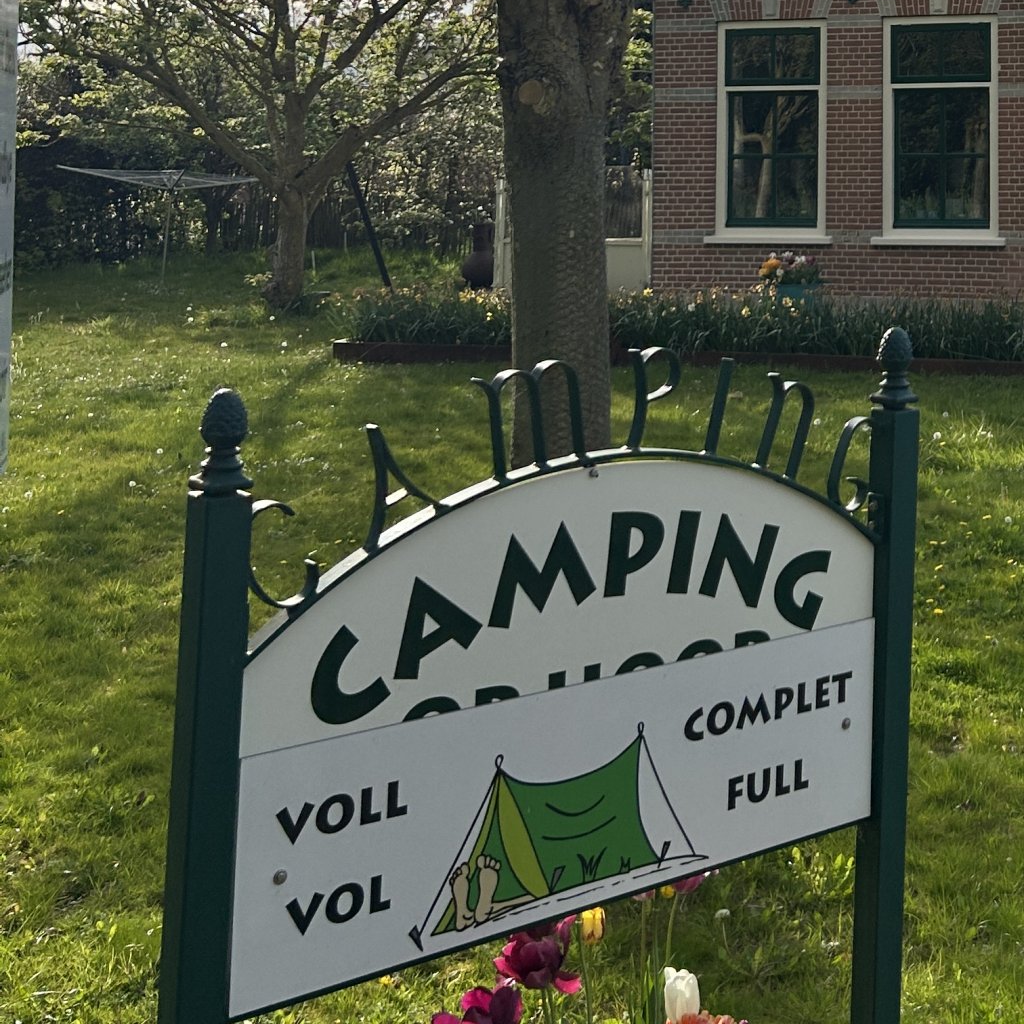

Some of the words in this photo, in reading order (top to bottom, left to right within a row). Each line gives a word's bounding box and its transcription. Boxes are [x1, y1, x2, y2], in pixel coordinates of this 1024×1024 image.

[310, 510, 832, 725] CAMPING
[683, 670, 853, 742] COMPLET
[275, 780, 408, 846] VOLL
[727, 758, 809, 811] FULL
[285, 874, 391, 936] VOL
